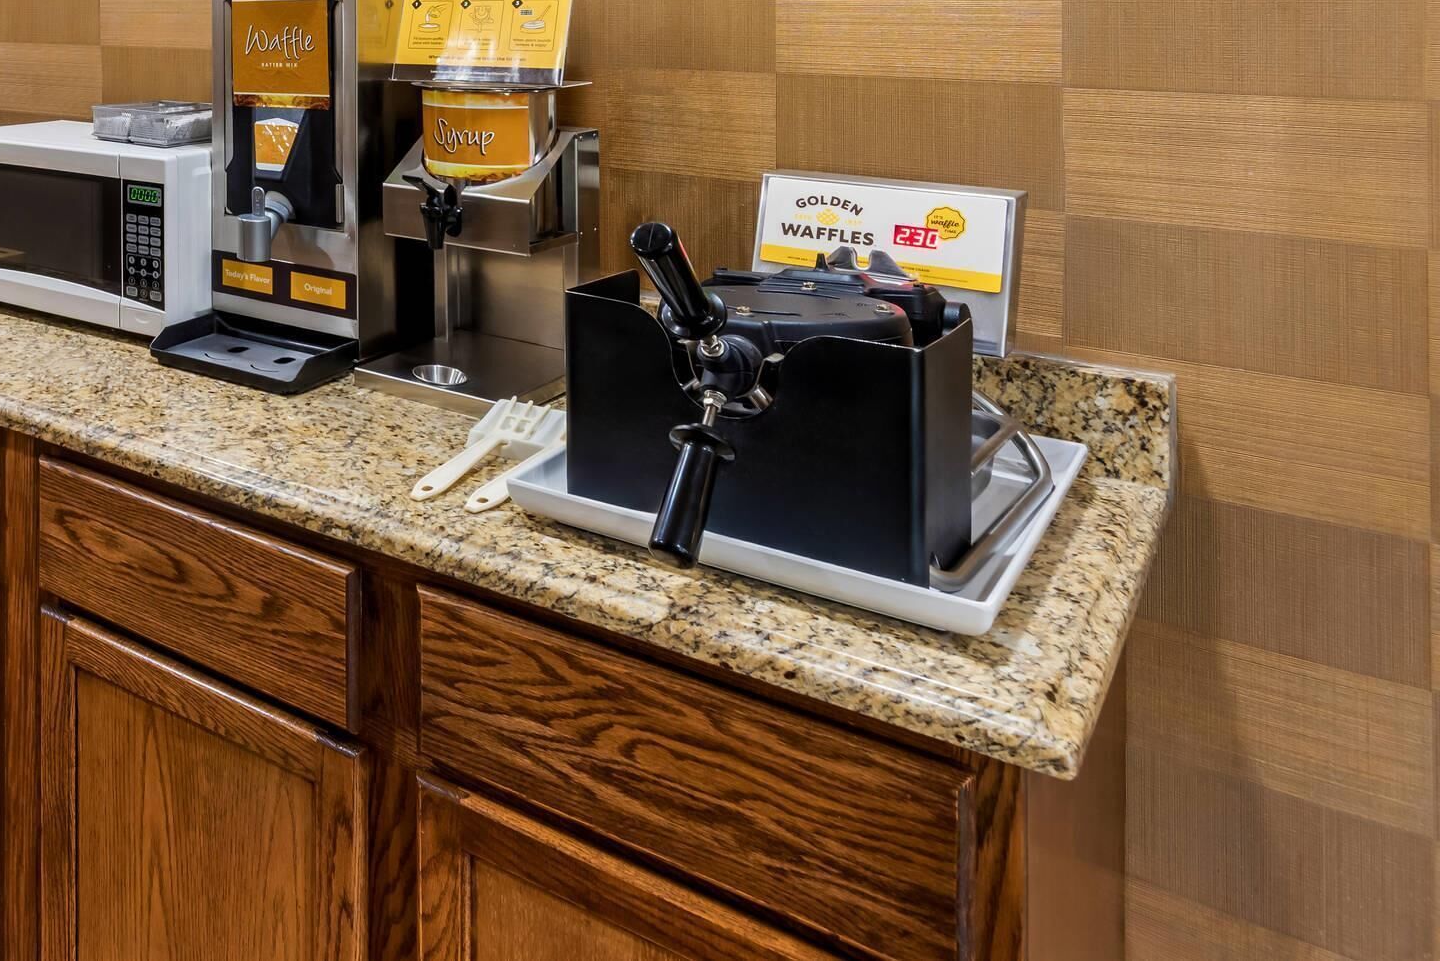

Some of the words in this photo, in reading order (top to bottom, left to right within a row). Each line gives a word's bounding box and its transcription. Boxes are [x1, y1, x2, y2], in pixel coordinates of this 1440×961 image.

[245, 24, 315, 60] Waffle
[434, 118, 496, 155] Syrup
[795, 194, 864, 217] GOLDEN
[781, 222, 875, 247] WAFFLES
[930, 219, 960, 229] waffle
[225, 269, 249, 281] Today's
[249, 273, 271, 284] Flavor
[303, 283, 333, 295] Original
